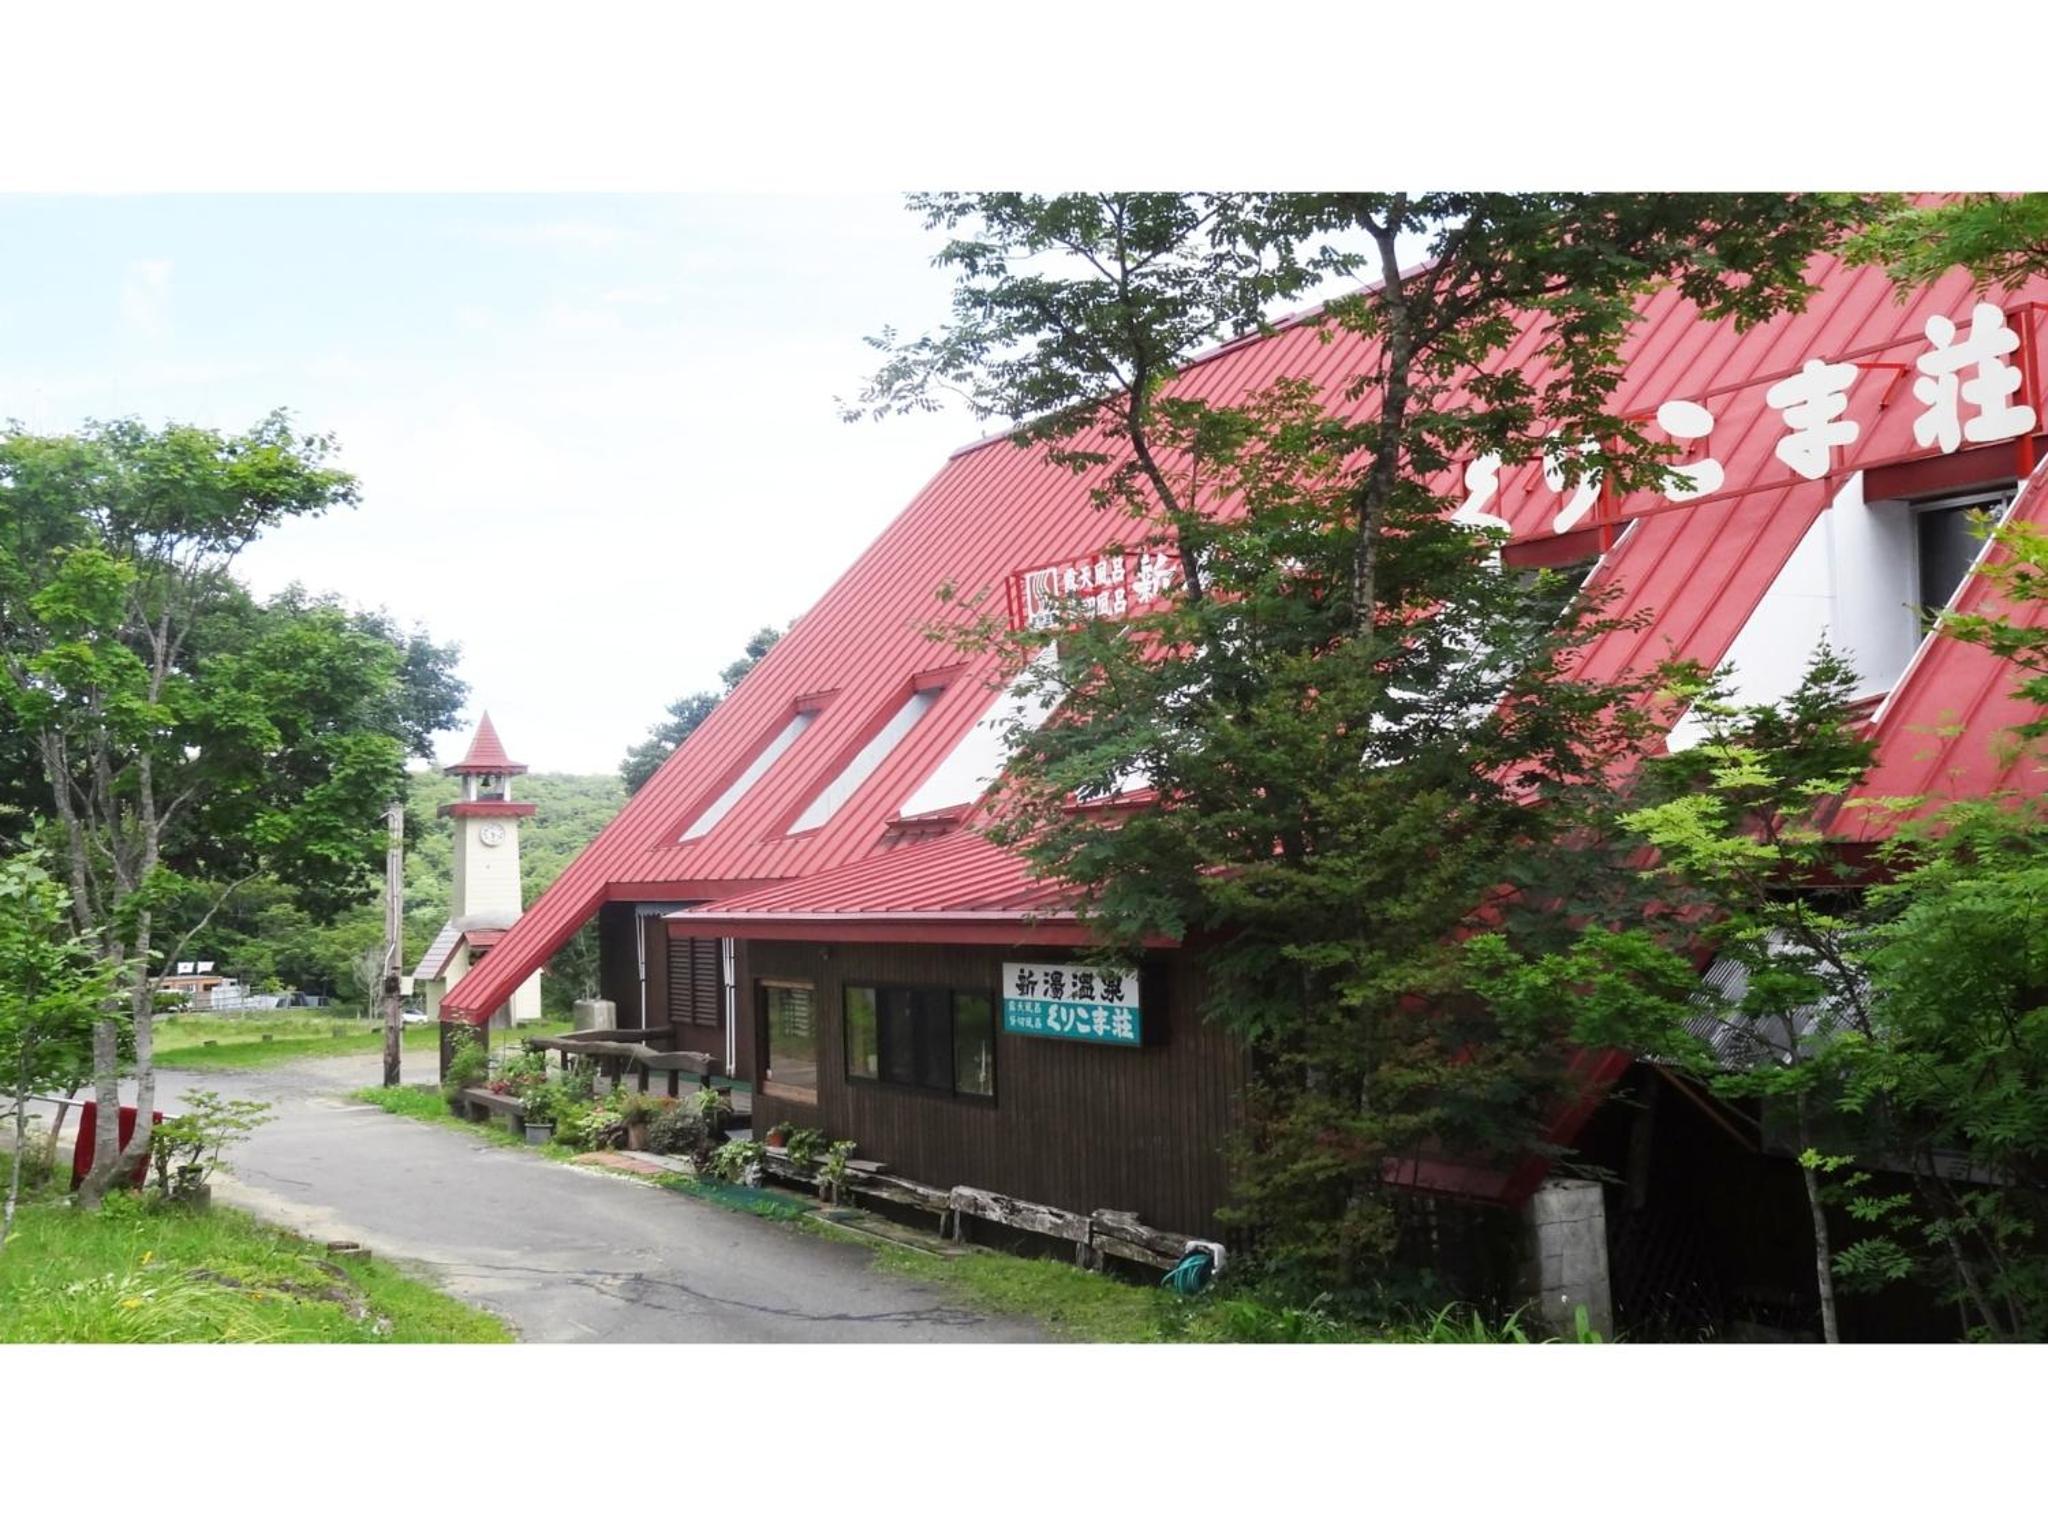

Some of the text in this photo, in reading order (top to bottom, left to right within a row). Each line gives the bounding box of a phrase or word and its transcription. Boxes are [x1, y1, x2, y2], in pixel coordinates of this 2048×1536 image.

[1016, 968, 1125, 1003] 新湯温泉
[1046, 1003, 1134, 1039] くりこま荘
